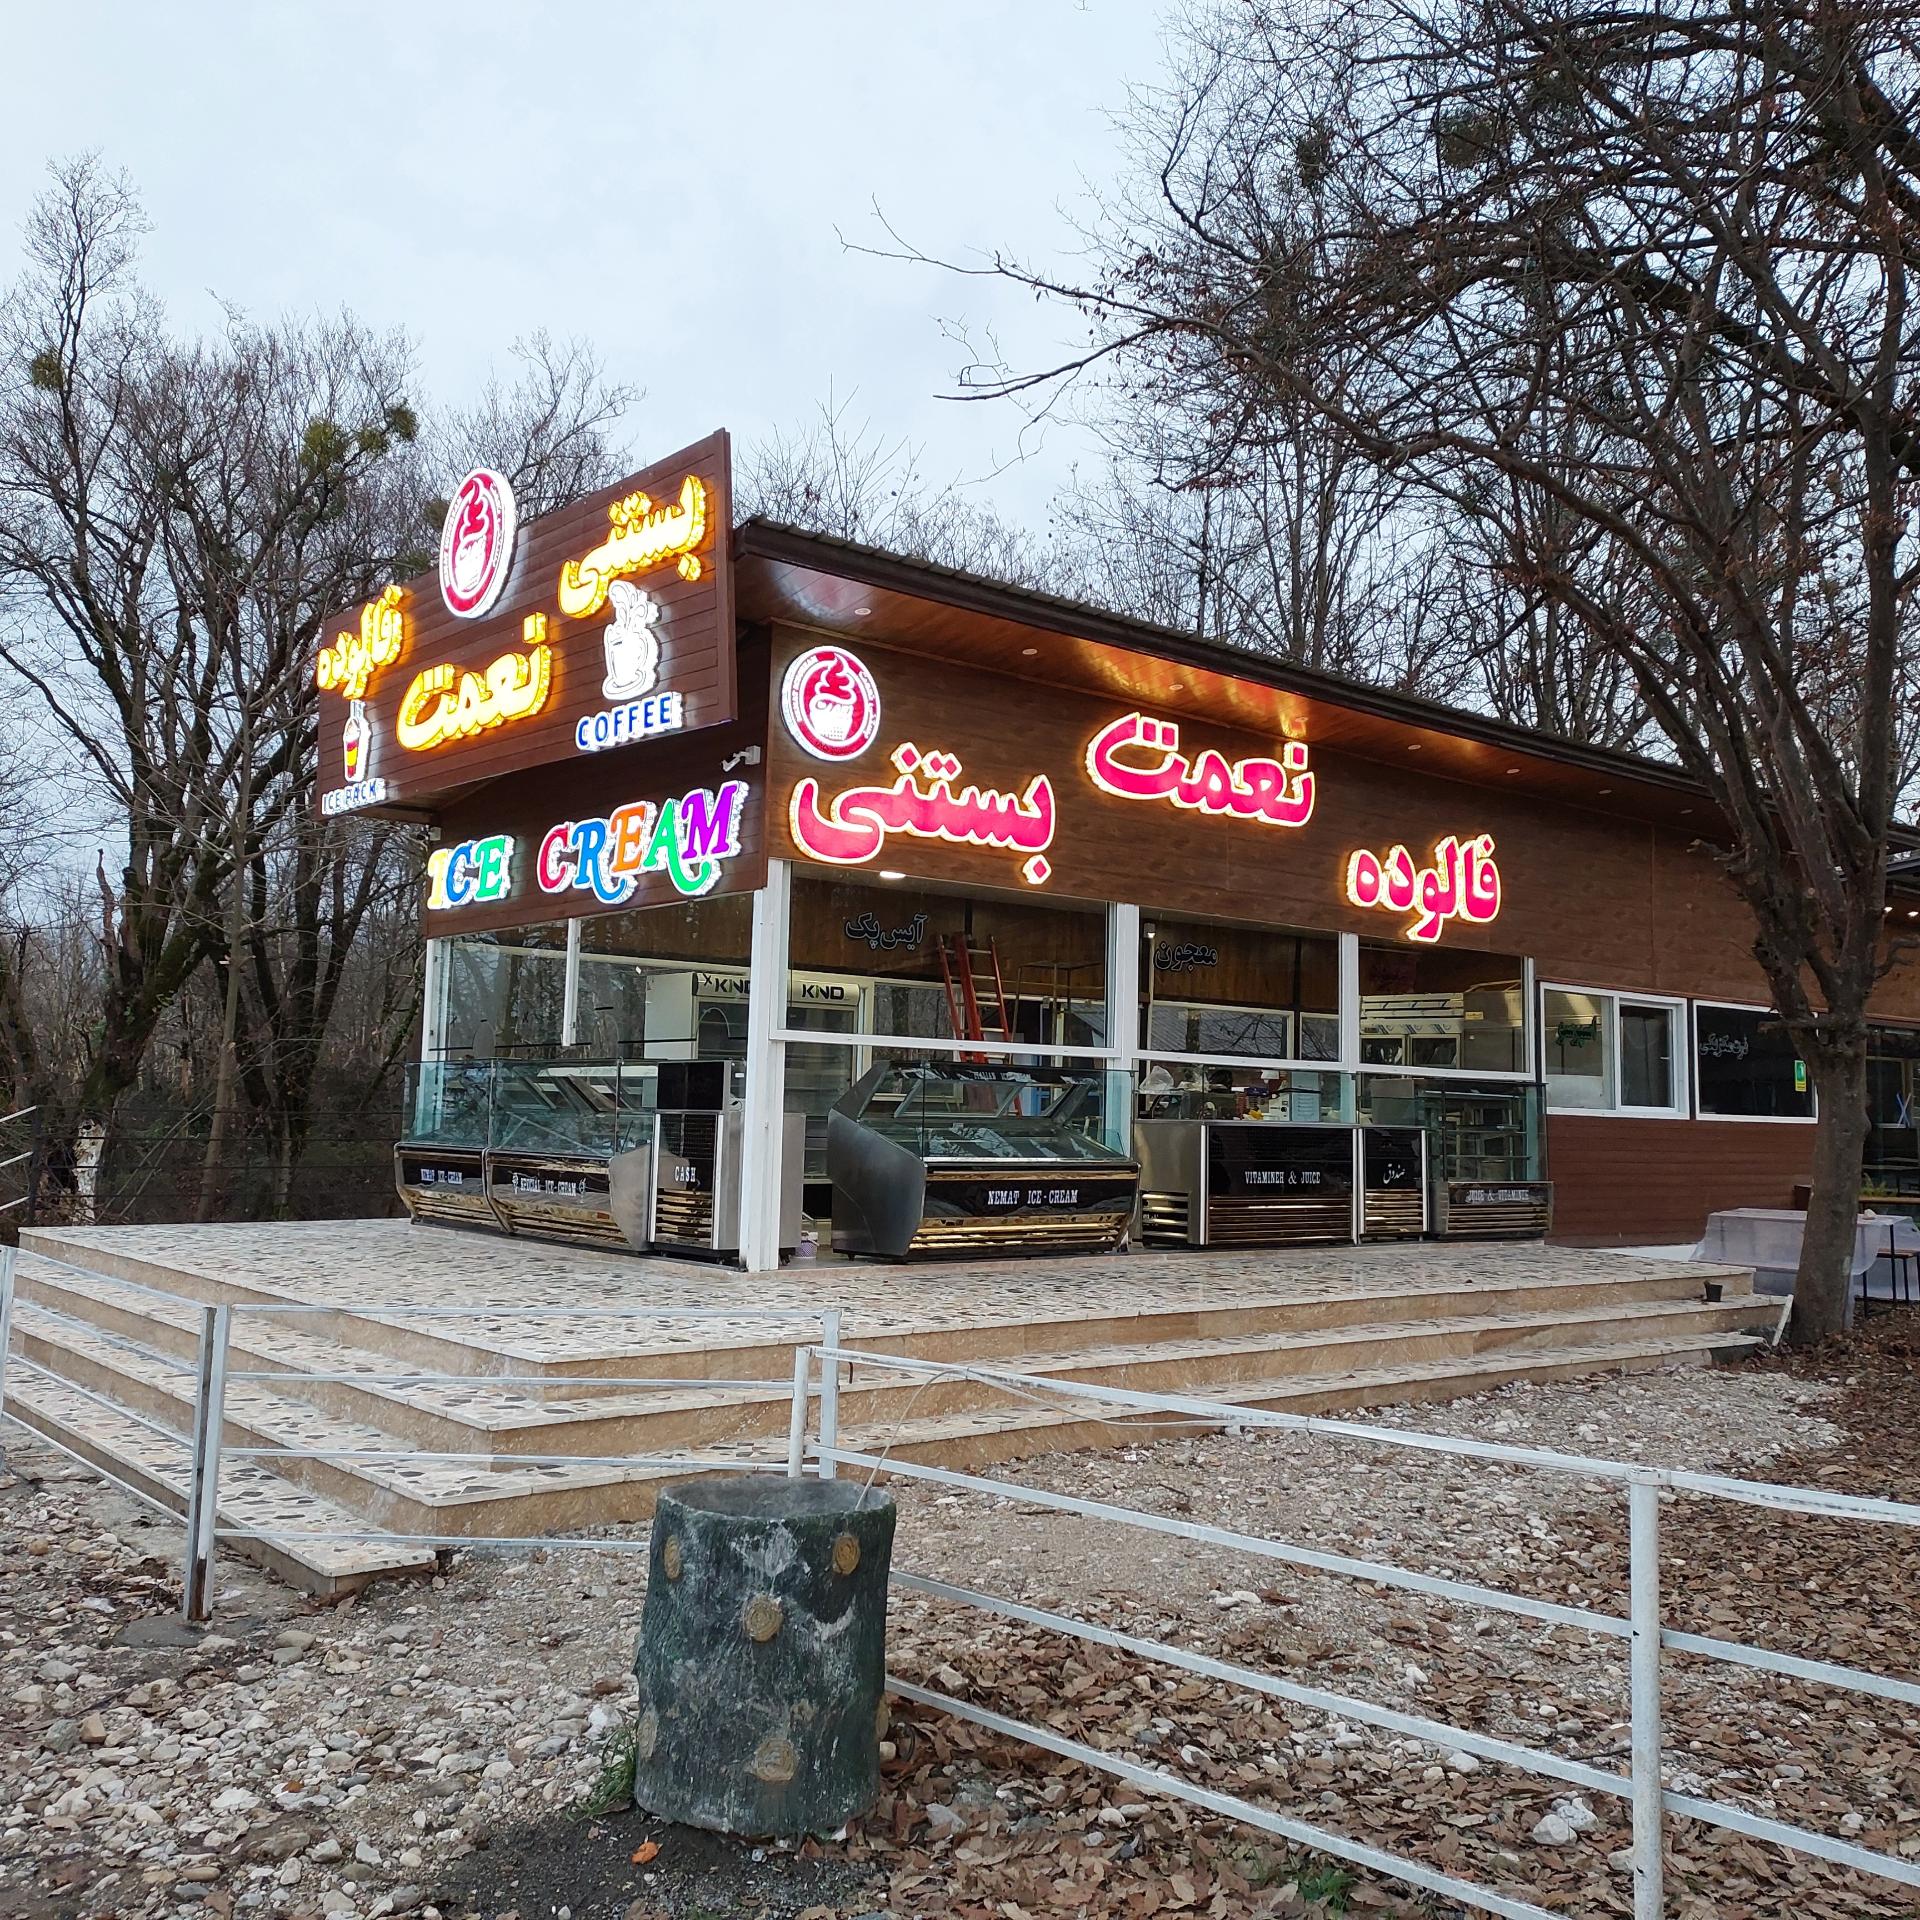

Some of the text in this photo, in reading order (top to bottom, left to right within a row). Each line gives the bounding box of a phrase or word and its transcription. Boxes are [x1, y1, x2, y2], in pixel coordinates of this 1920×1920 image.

[559, 475, 706, 619] بستنی
[316, 584, 404, 699] فالوده
[396, 612, 552, 752] نعمت
[577, 693, 676, 748] COFFEE
[324, 780, 379, 813] ICE PACK
[1086, 712, 1315, 826] نعمت
[428, 781, 749, 909] ICE CREAM
[789, 742, 1055, 884] بستنی
[1347, 834, 1501, 943] فالوده
[1154, 942, 1218, 972] معجون
[675, 1166, 696, 1182] CASH
[988, 1190, 1020, 1205] NEMAT
[1288, 1170, 1297, 1184] &
[1301, 1171, 1320, 1184] JUICE
[1383, 1163, 1405, 1184] صندوق
